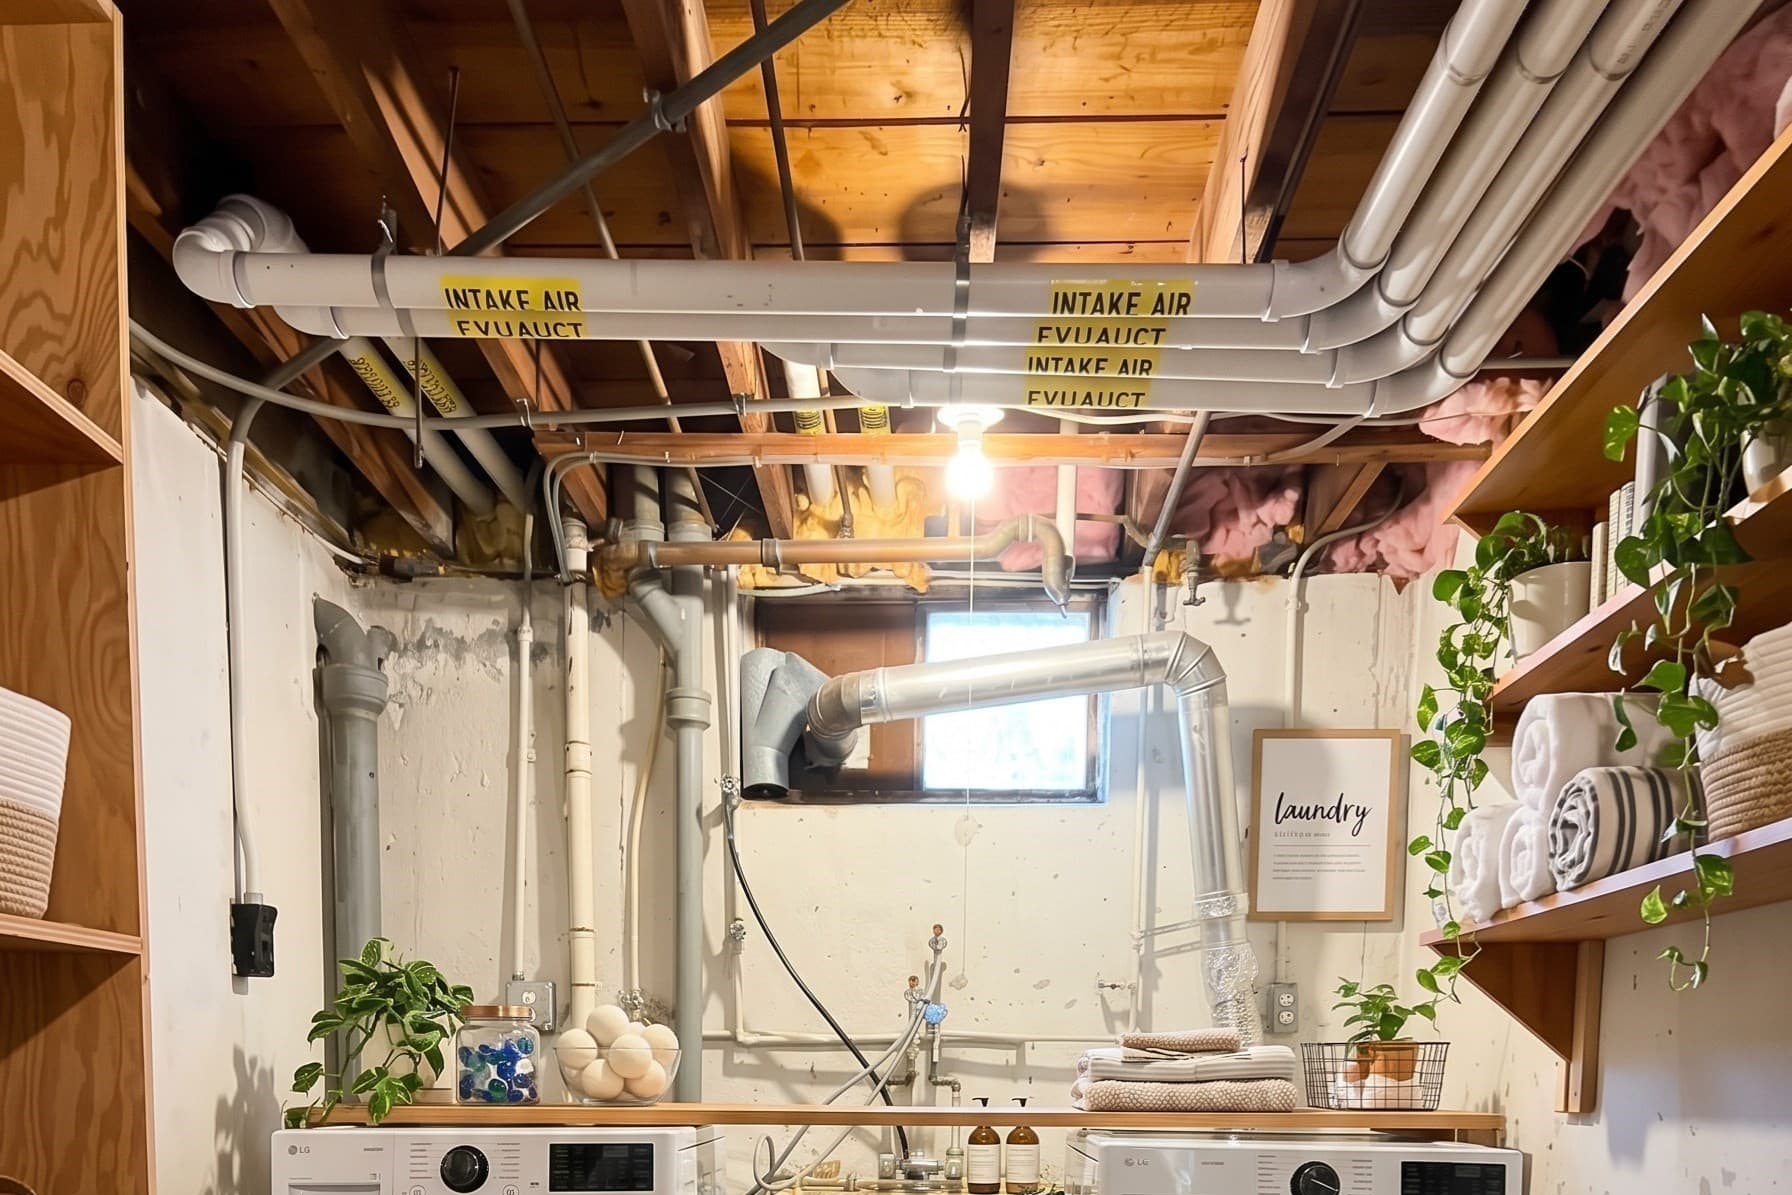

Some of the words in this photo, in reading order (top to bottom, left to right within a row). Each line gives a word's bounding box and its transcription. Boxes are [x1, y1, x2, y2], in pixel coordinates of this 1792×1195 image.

[444, 288, 530, 311] INTAKE
[543, 290, 582, 312] AIR
[1052, 291, 1142, 316] INTAKE
[1150, 291, 1192, 316] AIR
[1028, 356, 1109, 374] INTAKE
[1117, 358, 1153, 376] AIR
[1274, 791, 1373, 838] laundry
